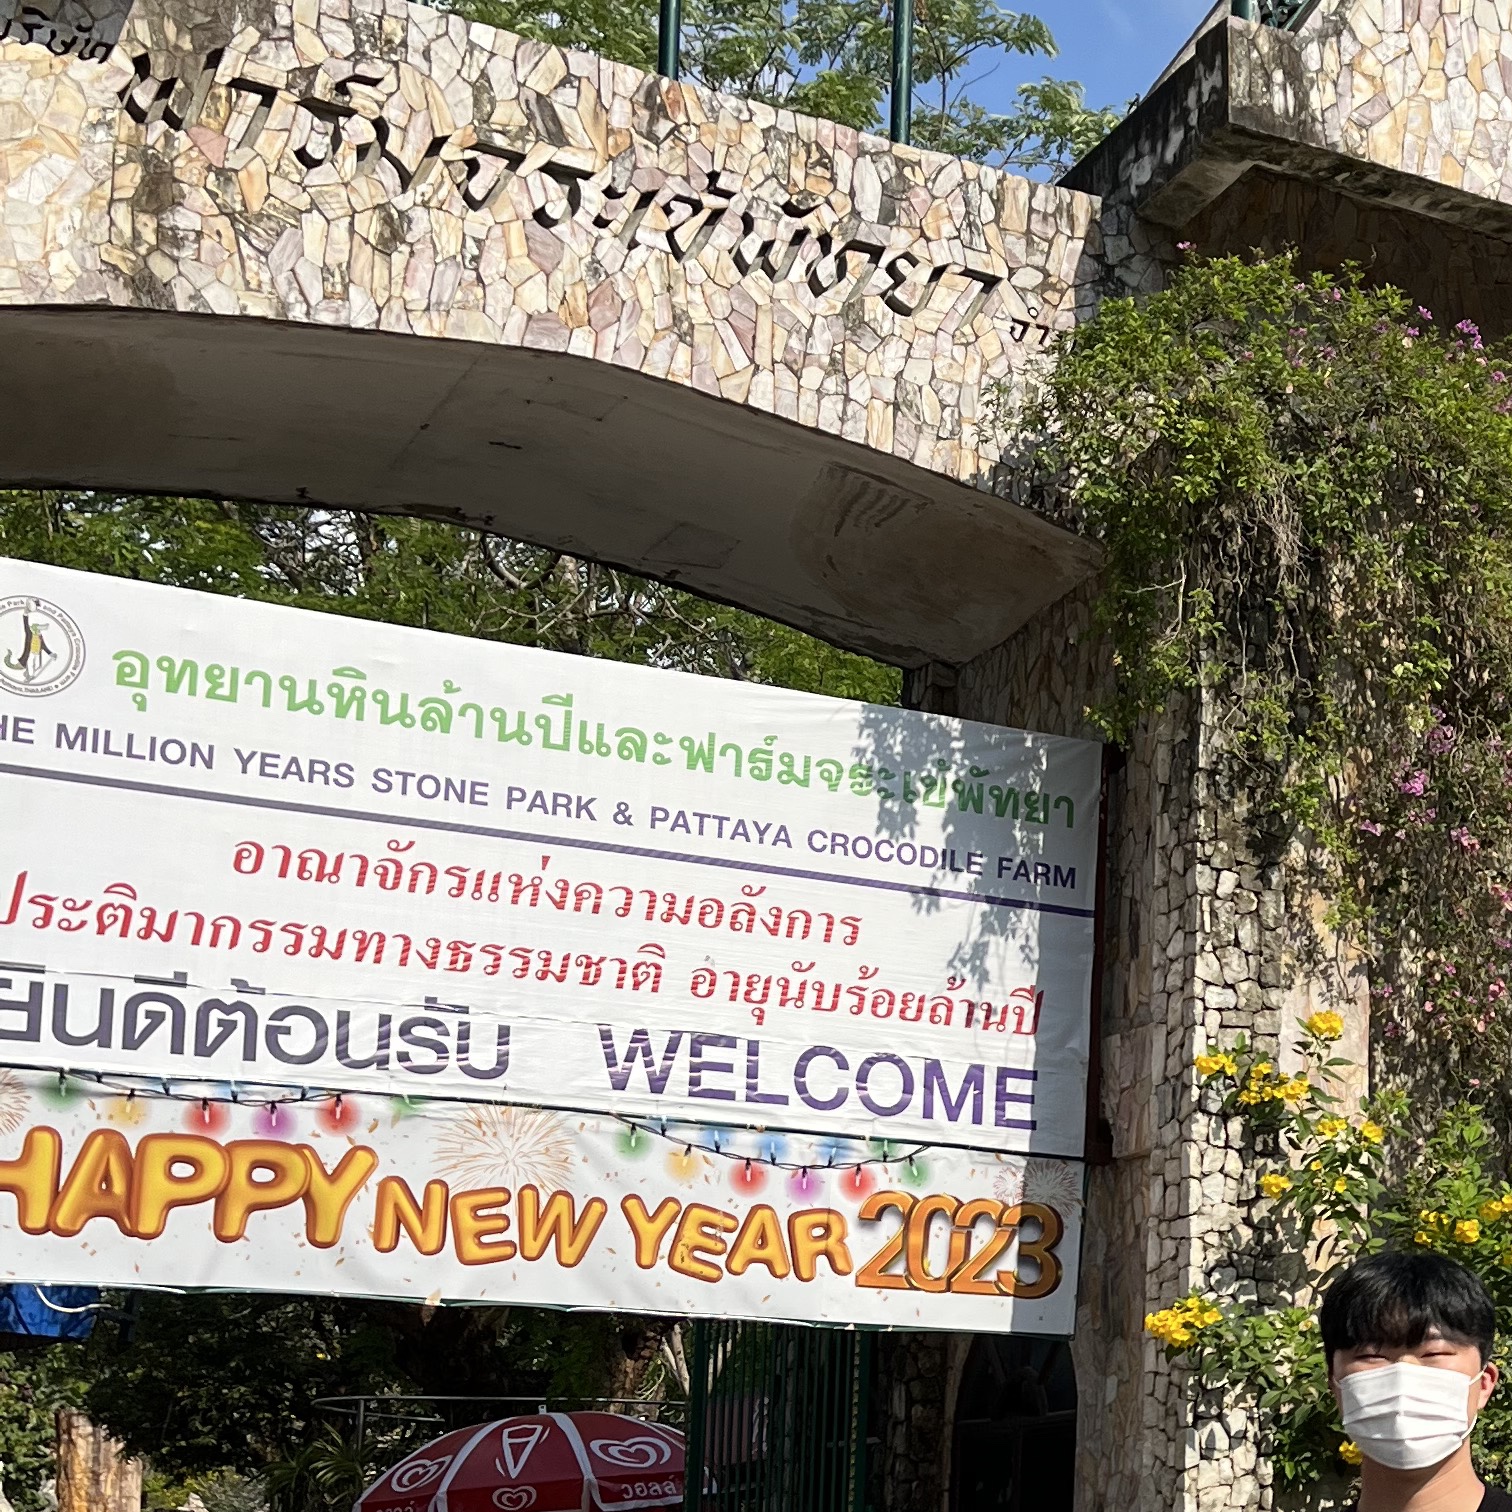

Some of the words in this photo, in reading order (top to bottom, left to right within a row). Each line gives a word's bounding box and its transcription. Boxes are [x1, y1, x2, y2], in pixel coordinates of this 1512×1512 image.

[112, 649, 1075, 829] อุทยานหินล้านปีและฟาร์มจระเข้พัทยา
[55, 722, 215, 770] MILLION
[233, 747, 356, 789] YEARS
[371, 767, 490, 807] STONE
[506, 786, 598, 822] PARK
[612, 801, 634, 826] &
[650, 805, 793, 849] PATTAYA
[807, 829, 984, 877] CROCODILE
[997, 856, 1077, 890] FARM
[233, 839, 863, 946] อาณาจักรแห่งความอลังการ
[690, 959, 1045, 1036] อายุนับร้อยล้านปี
[597, 1023, 1038, 1131] WELCOME
[373, 1175, 608, 1269] NEW
[621, 1192, 855, 1284] YEAR
[855, 1189, 1064, 1299] 2023
